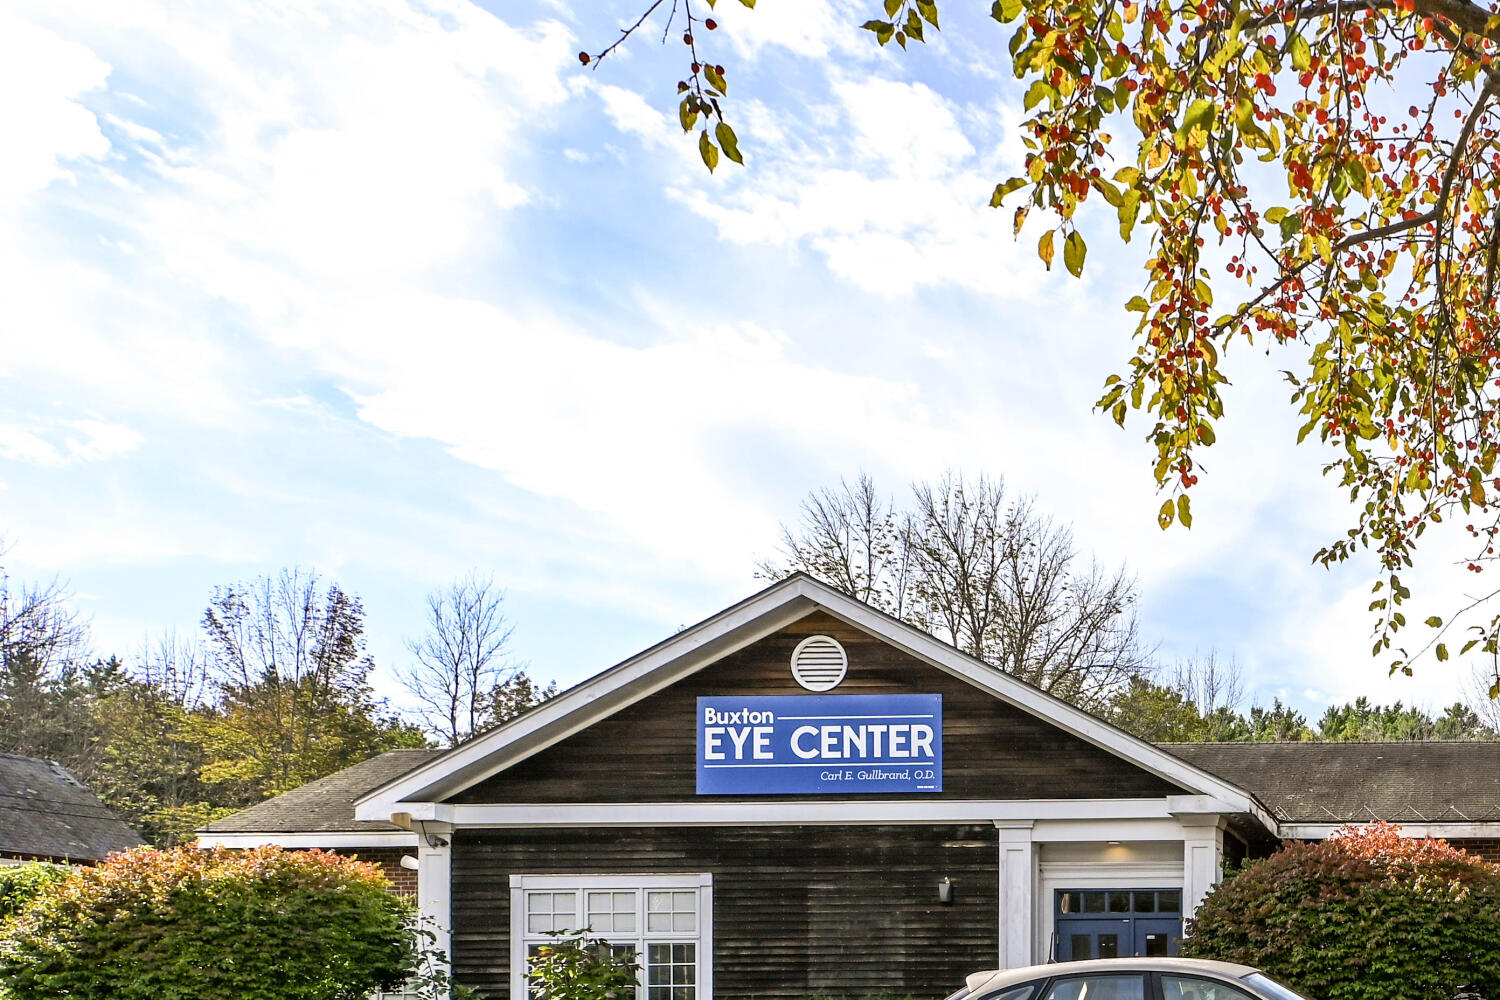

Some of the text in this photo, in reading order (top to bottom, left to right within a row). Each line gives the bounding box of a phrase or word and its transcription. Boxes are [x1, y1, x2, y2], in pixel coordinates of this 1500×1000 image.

[705, 707, 774, 725] Buxton
[705, 724, 935, 760] EYE CENTER
[820, 769, 935, 781] Carl E. Gullbrand, O.D.
